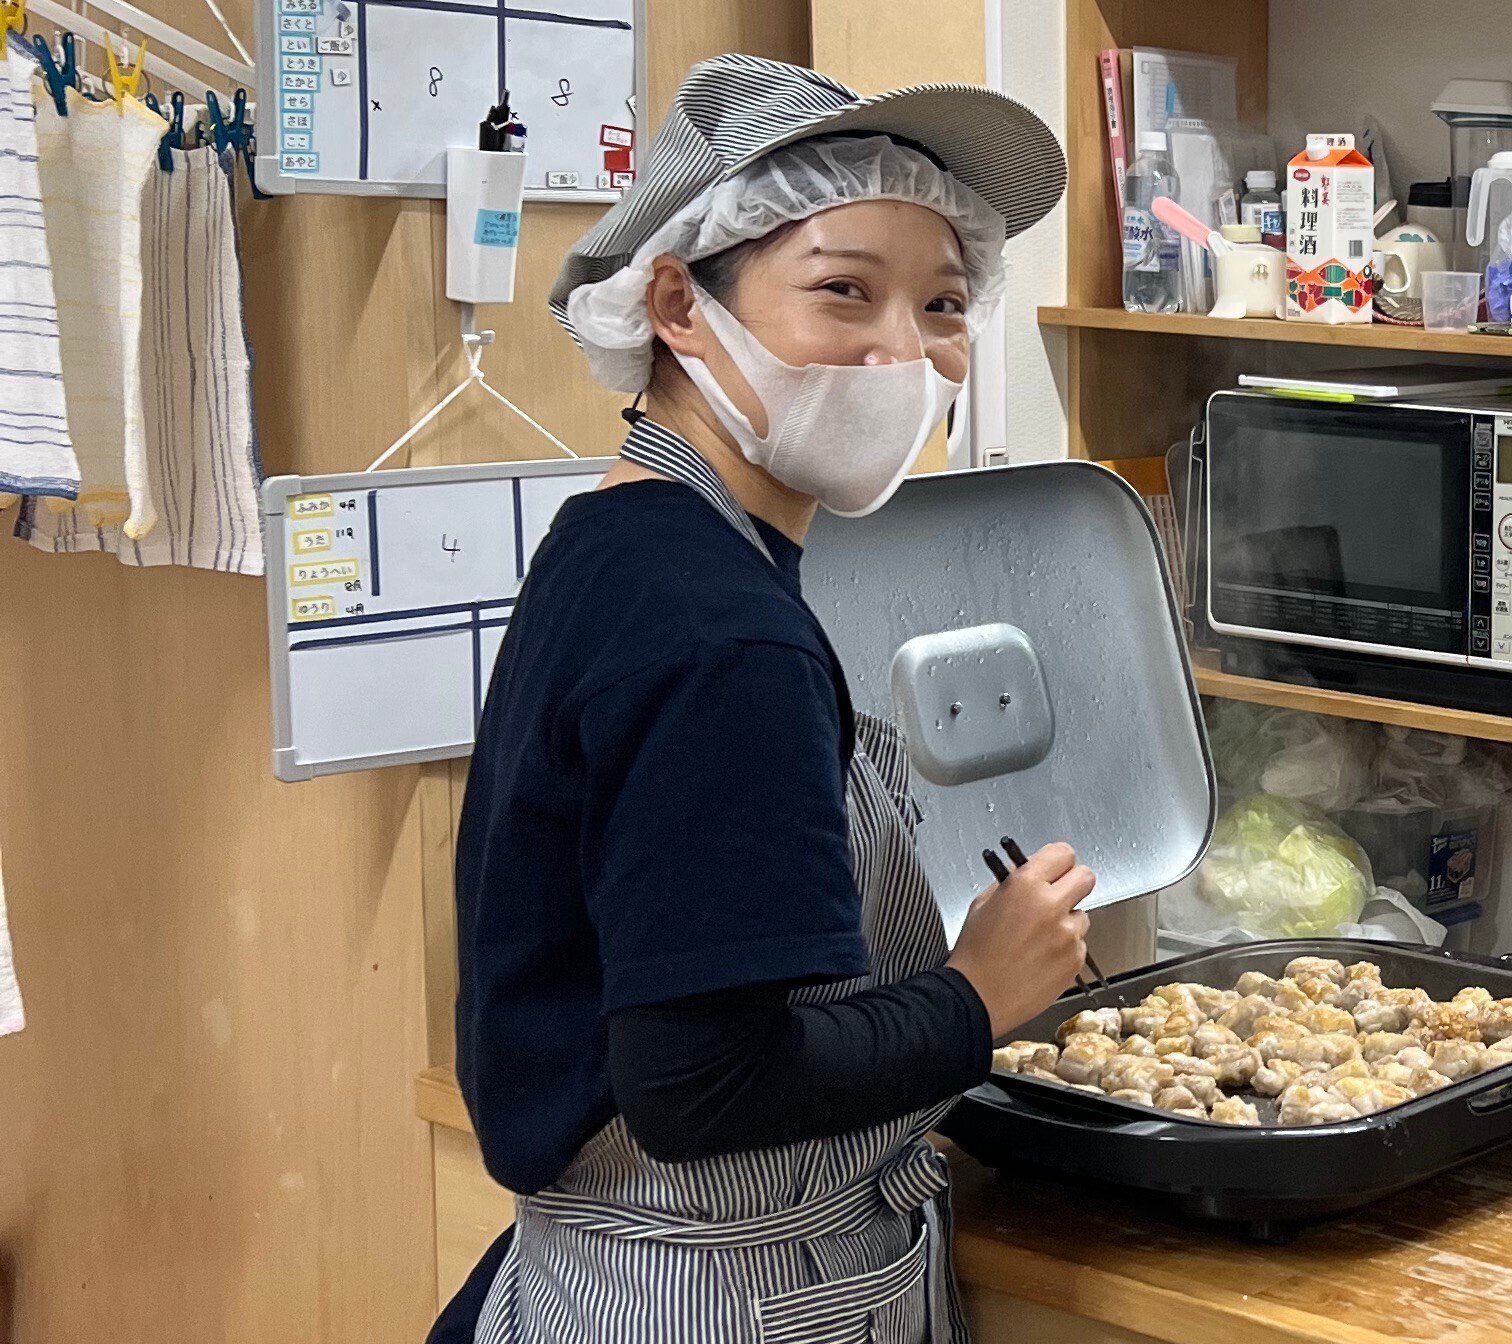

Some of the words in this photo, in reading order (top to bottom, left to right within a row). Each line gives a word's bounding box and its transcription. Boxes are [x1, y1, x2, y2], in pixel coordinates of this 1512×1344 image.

[285, 0, 317, 10] みちる
[283, 19, 312, 30] さくと
[287, 40, 306, 50] とい
[286, 58, 316, 69] とうき
[285, 77, 314, 89] たかと
[428, 67, 443, 97] 8
[551, 78, 574, 106] 8
[287, 96, 308, 107] せら
[287, 116, 307, 127] さほ
[286, 136, 306, 147] ここ
[285, 156, 316, 167] あやと
[1300, 187, 1319, 256] 料理酒
[297, 501, 329, 513] ふみか
[442, 534, 461, 563] 4
[299, 566, 352, 579] りょうへい
[298, 602, 329, 614] ゆうり
